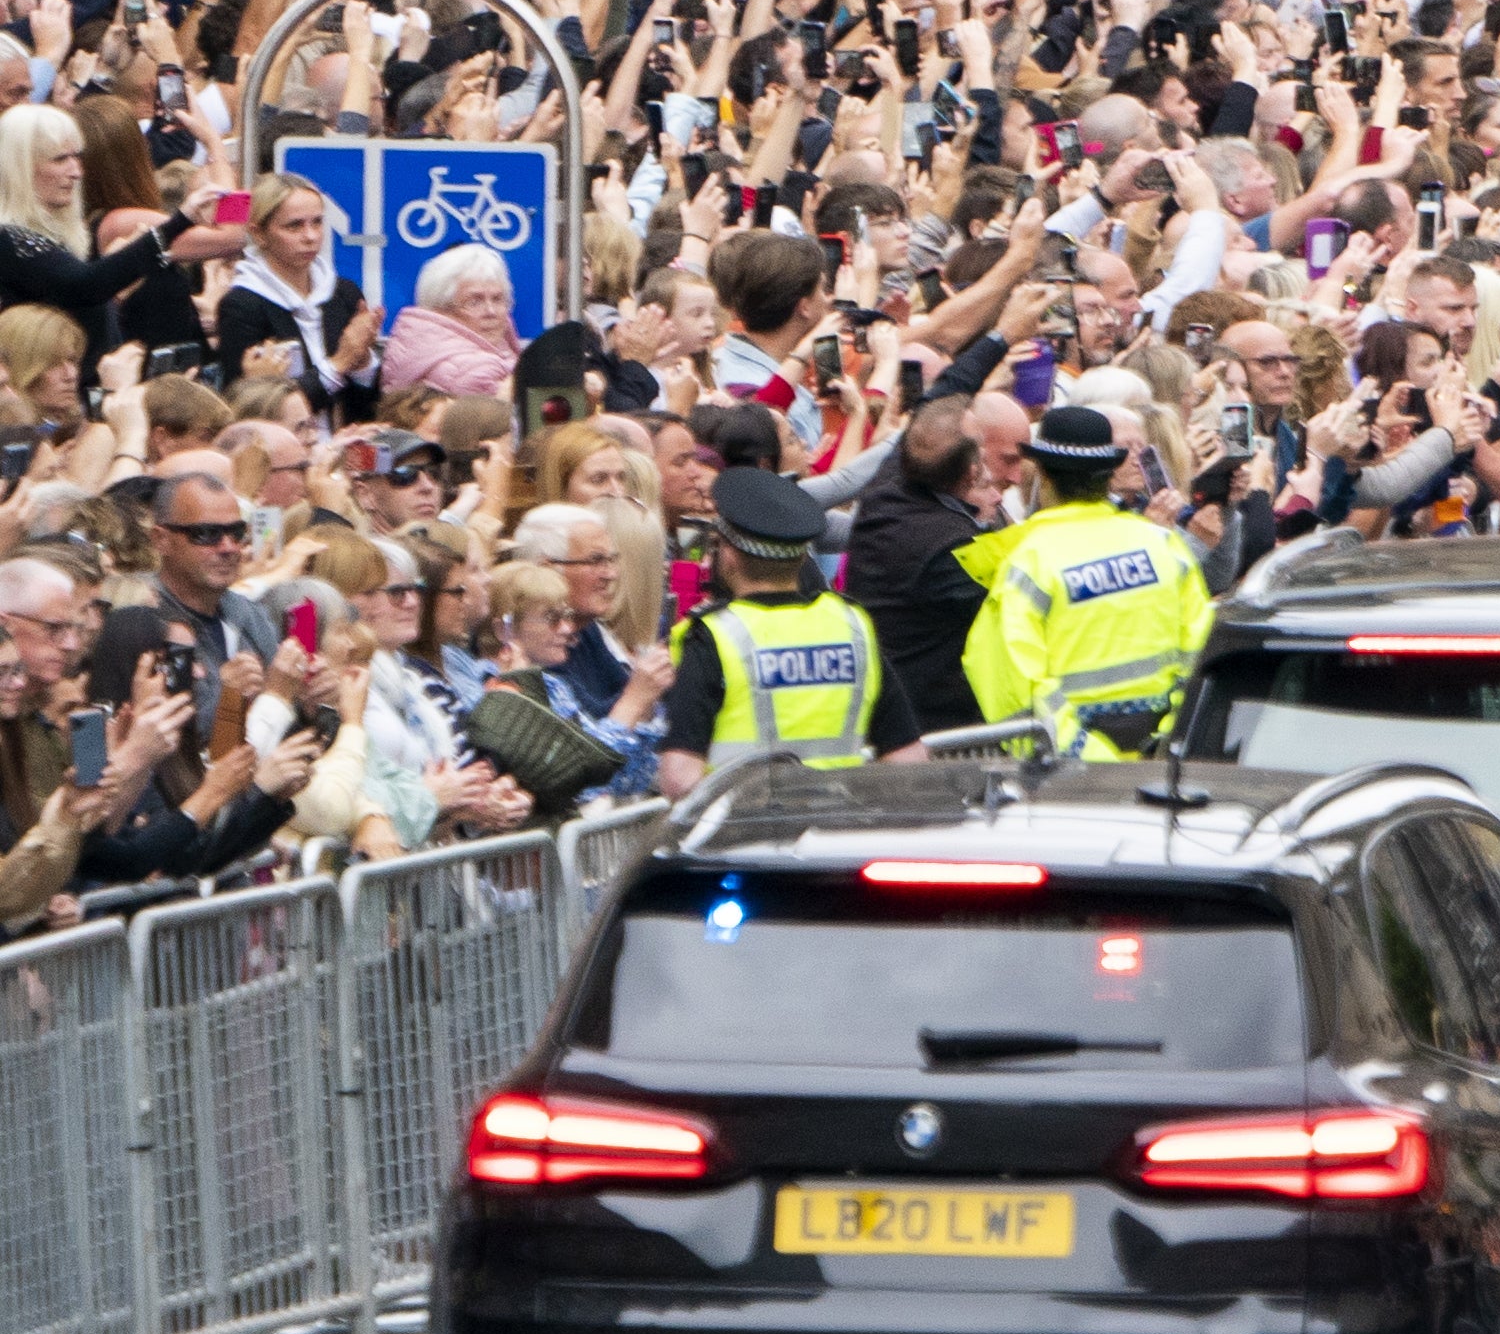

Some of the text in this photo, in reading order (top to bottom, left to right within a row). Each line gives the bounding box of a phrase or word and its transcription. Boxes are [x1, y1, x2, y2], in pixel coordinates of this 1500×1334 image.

[1065, 553, 1157, 597] POLICE
[760, 647, 856, 685] POLICE
[800, 1197, 1047, 1246] LB20 LWF
